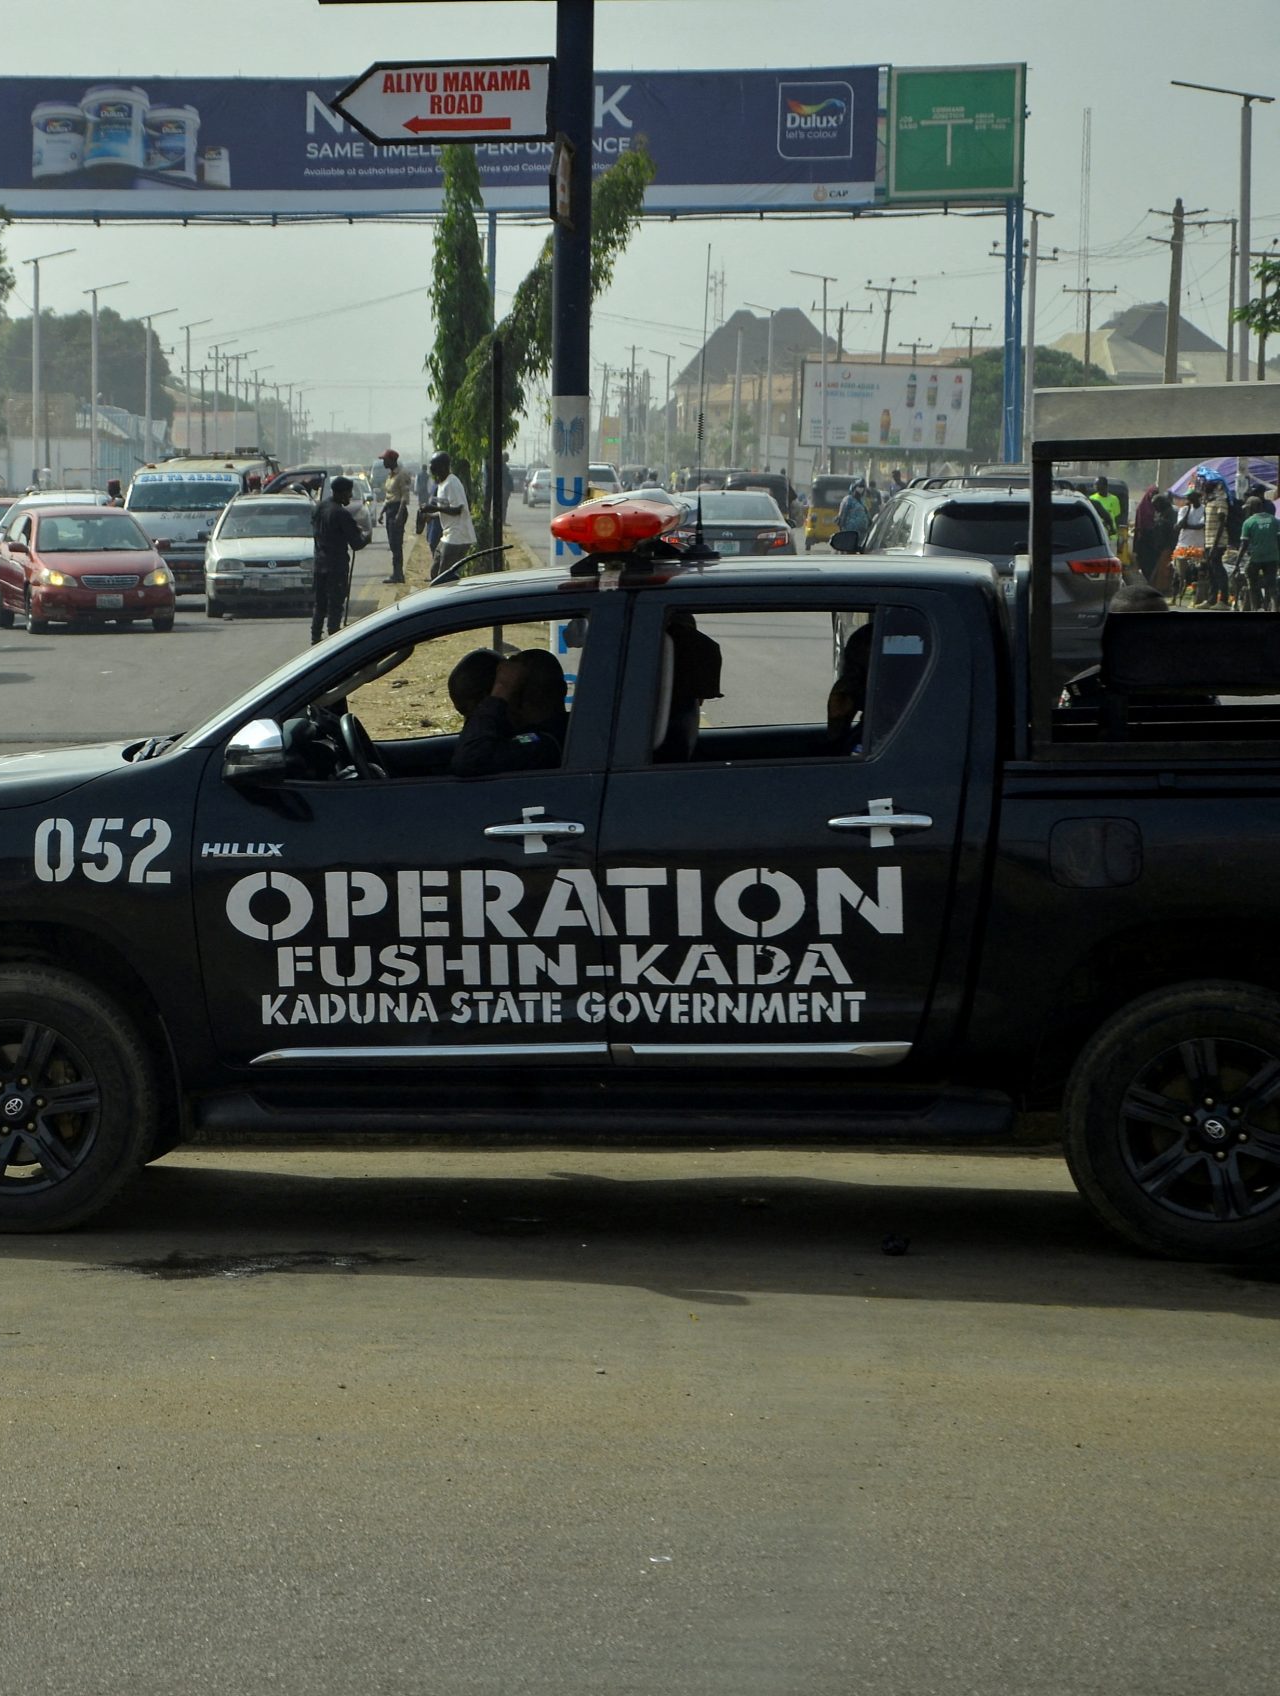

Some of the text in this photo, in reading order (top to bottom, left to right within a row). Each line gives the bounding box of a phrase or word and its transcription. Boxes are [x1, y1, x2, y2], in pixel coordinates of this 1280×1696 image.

[382, 68, 531, 94] ALIYU MAKAMA
[429, 93, 484, 116] ROAD
[786, 112, 838, 129] Dulux
[306, 142, 365, 160] SAME
[303, 166, 345, 177] Available
[347, 168, 357, 176] at
[357, 165, 406, 176] authorised
[407, 165, 434, 175] Dulux
[502, 163, 520, 173] and
[521, 162, 552, 173] Colou
[829, 189, 849, 199] CAP
[34, 817, 172, 884] 052
[201, 842, 285, 857] HILUX
[225, 866, 904, 941] OPERATION
[277, 943, 854, 987] FUSHIN-KADA
[261, 990, 867, 1025] KADUNA STATE GOVERNMENT
